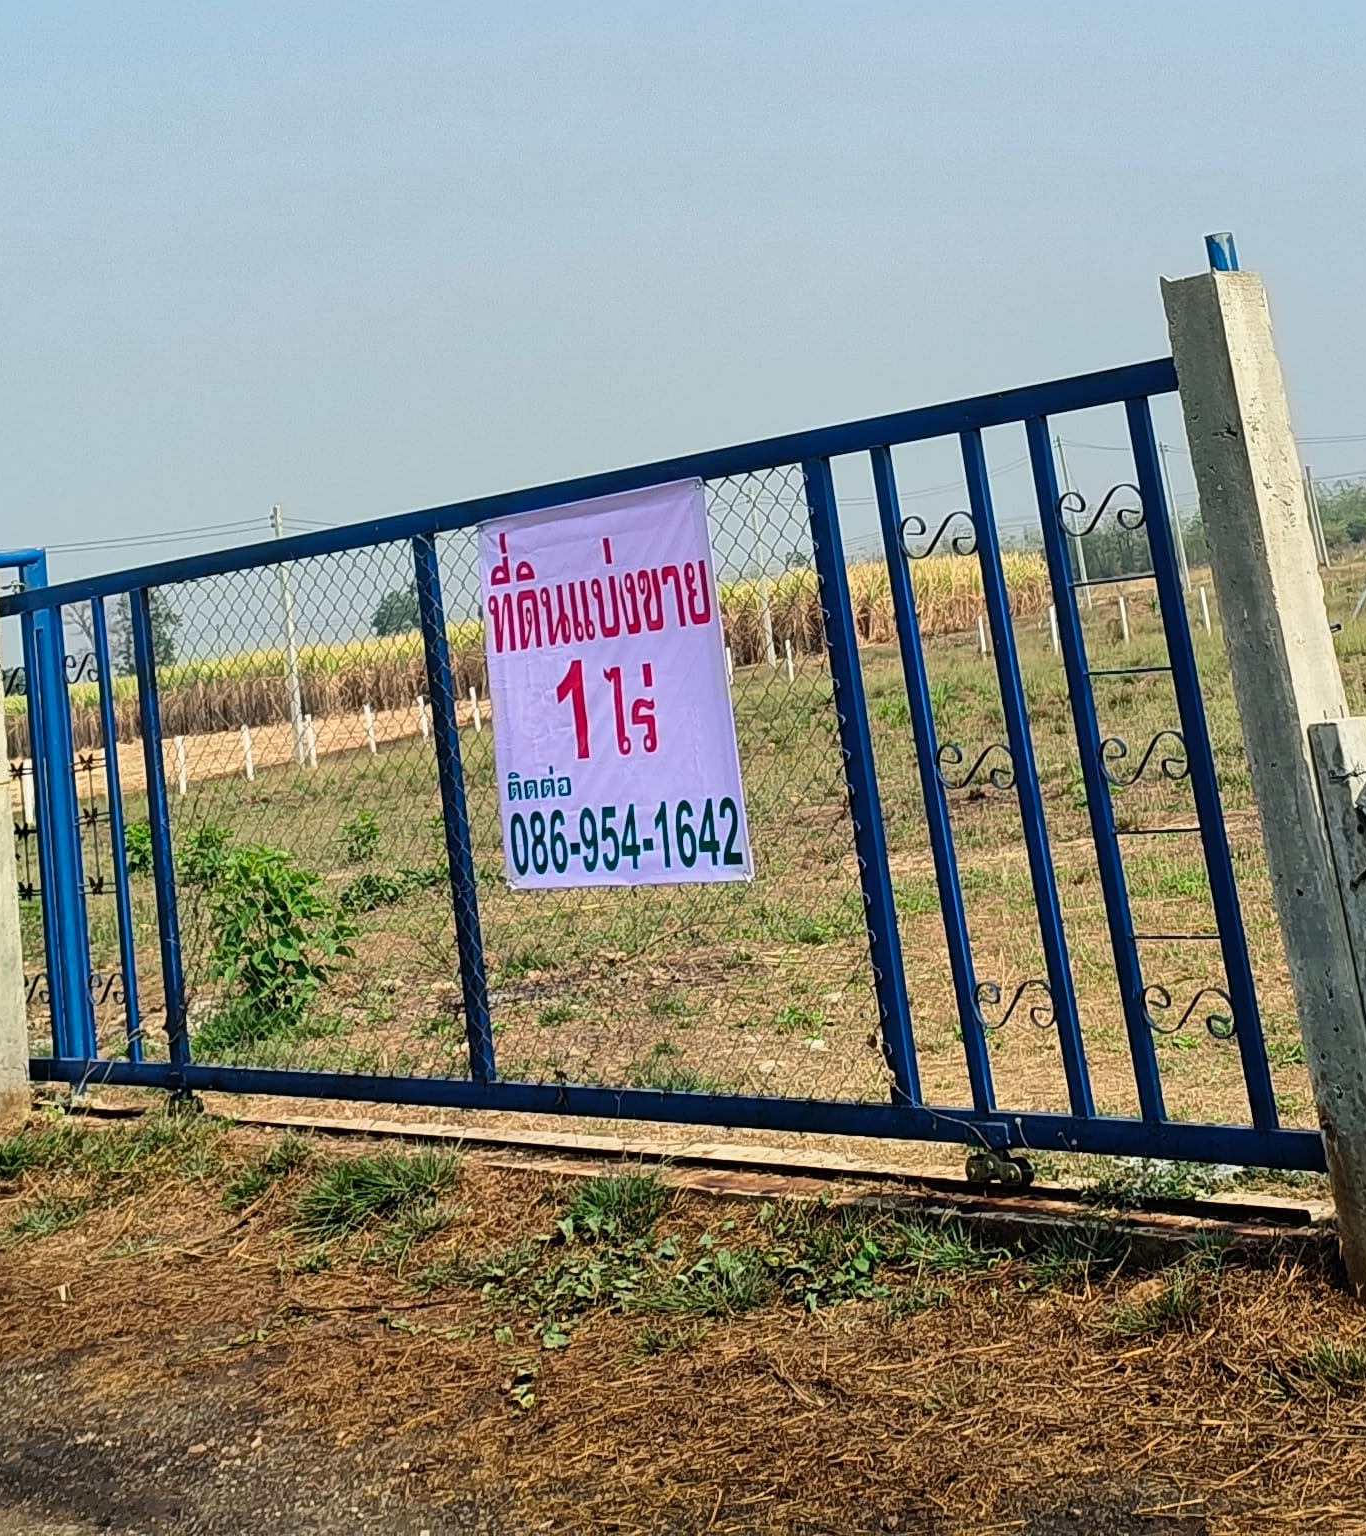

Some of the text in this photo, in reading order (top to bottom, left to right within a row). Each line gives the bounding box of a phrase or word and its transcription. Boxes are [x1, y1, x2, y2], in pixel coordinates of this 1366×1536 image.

[488, 532, 711, 654] ที่ดินแบ่งขาย
[557, 659, 658, 760] 1 ไร่
[508, 765, 572, 801] ติดต่อ
[510, 796, 743, 876] 086-954-1642
